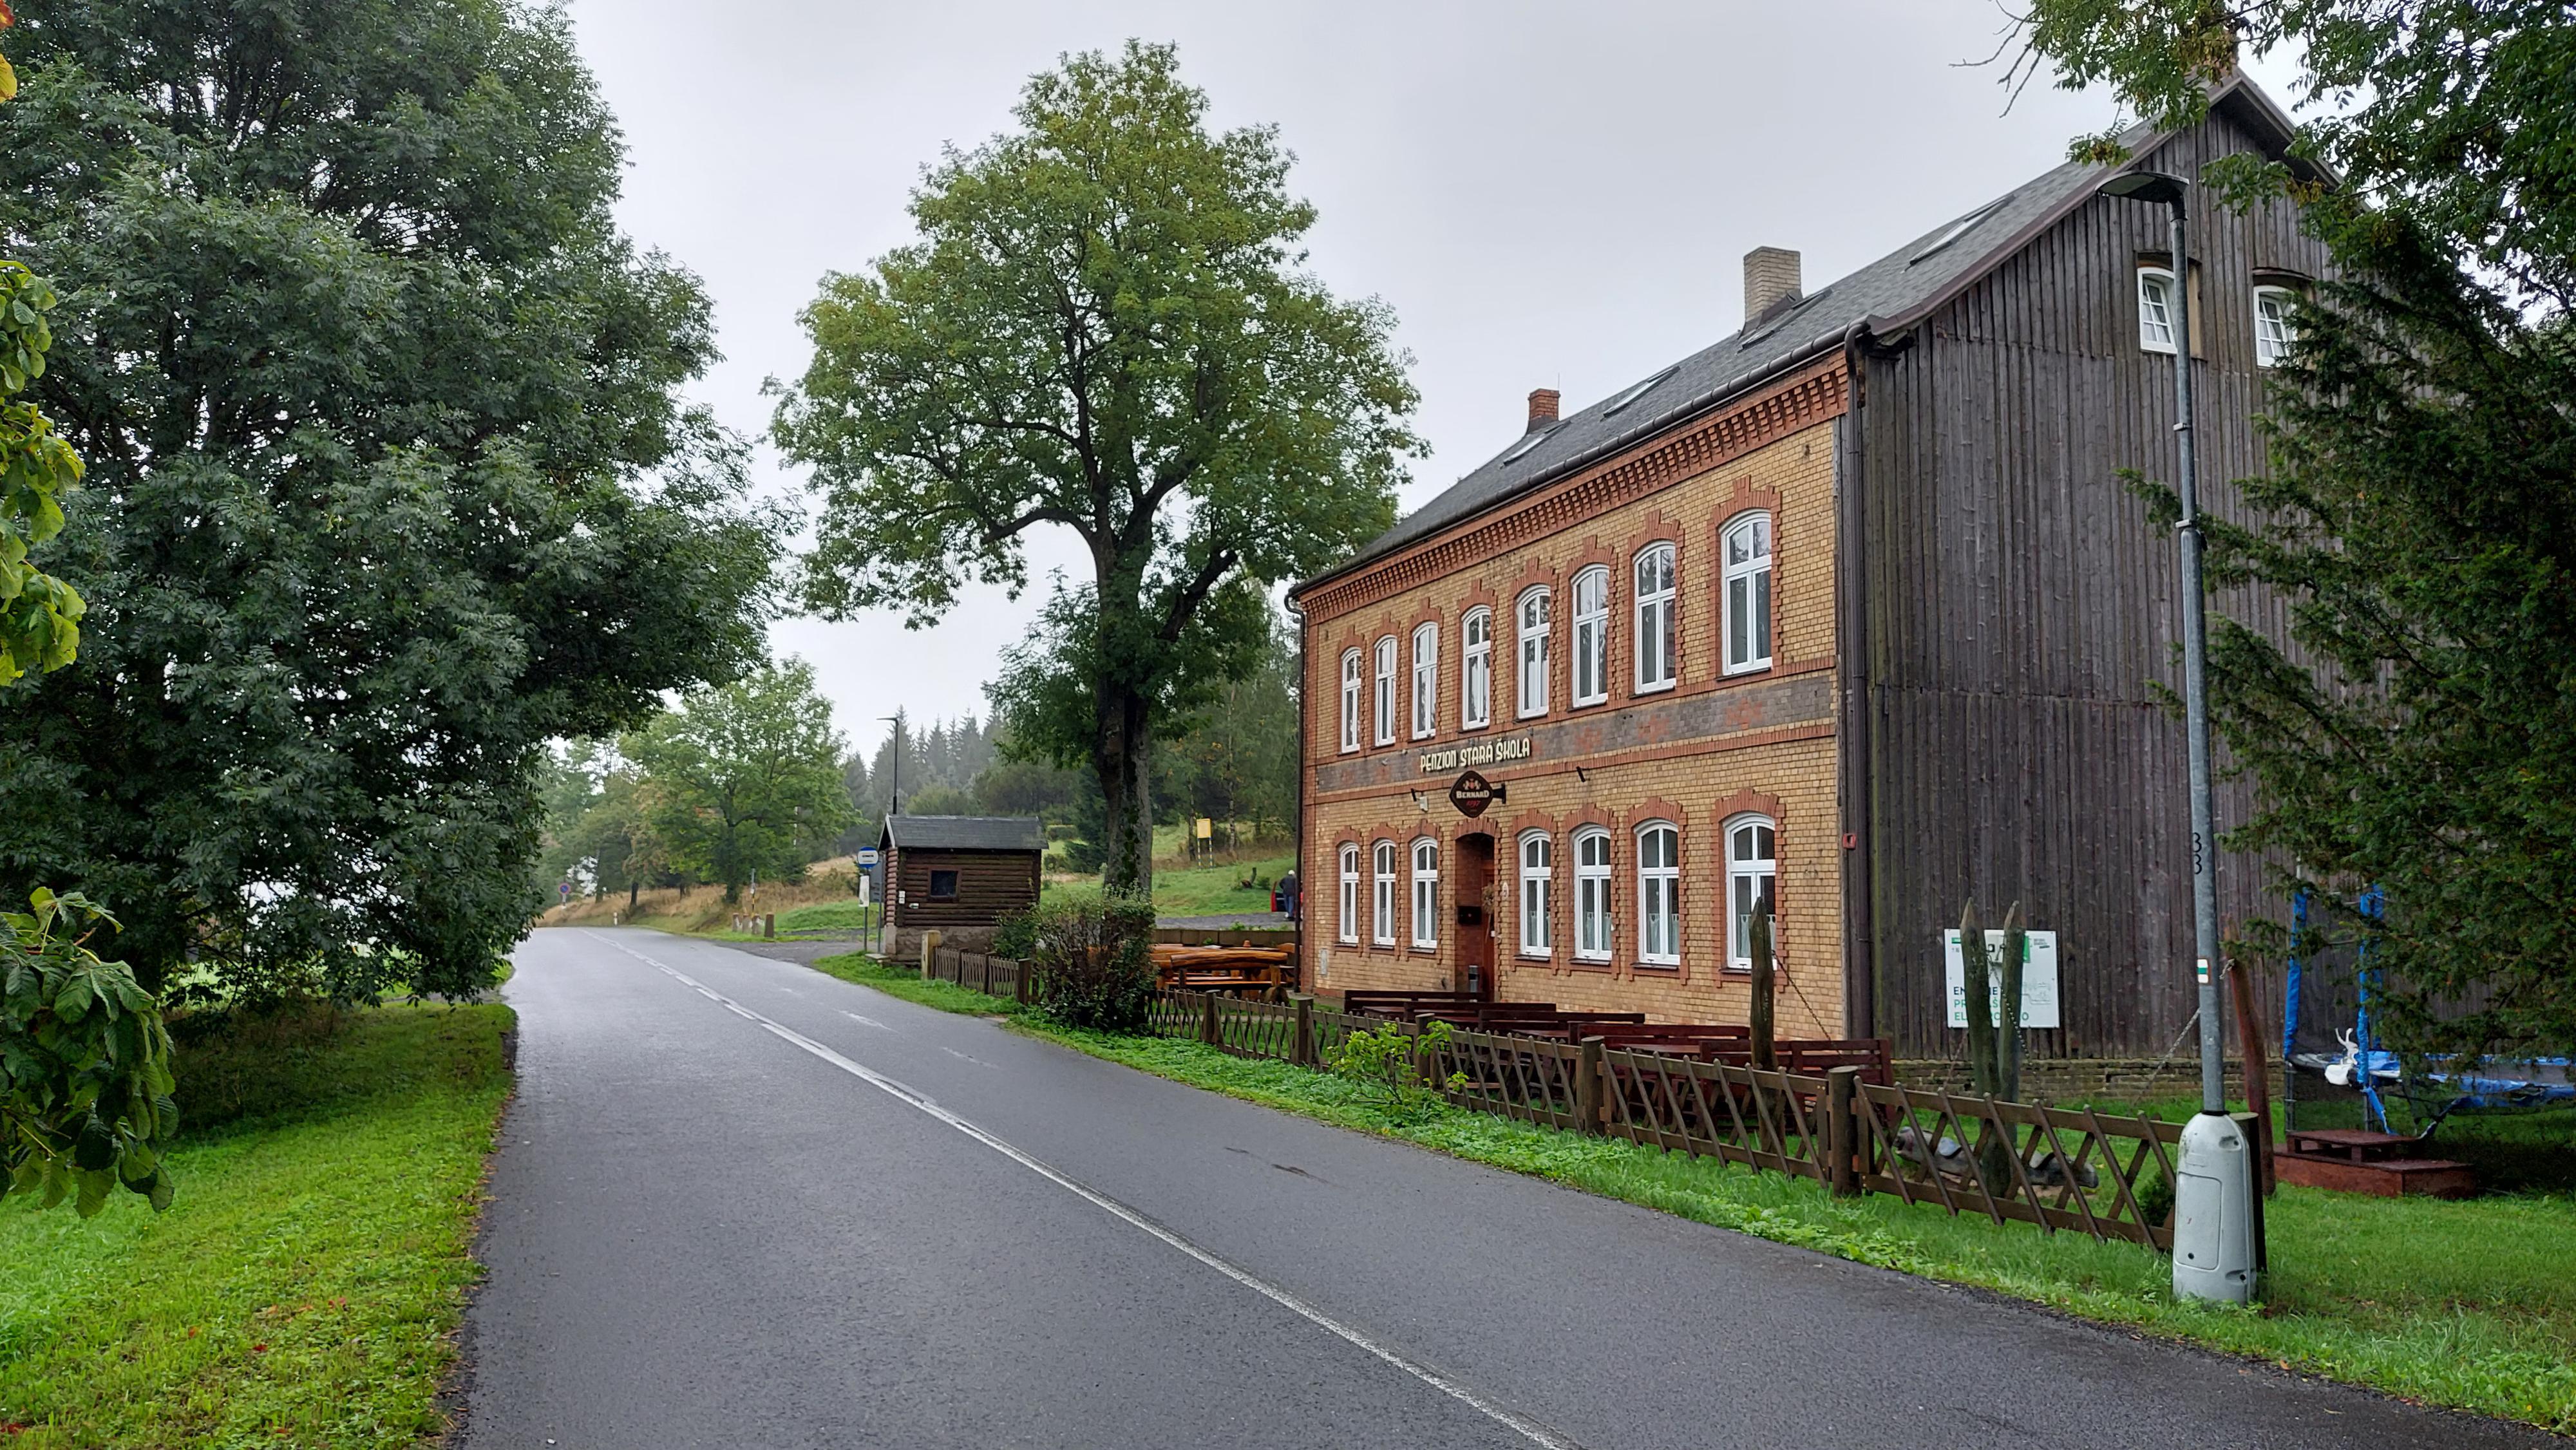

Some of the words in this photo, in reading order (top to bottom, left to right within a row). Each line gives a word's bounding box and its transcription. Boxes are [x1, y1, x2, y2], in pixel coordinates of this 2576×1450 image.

[1420, 749, 1457, 772] PENZION
[1460, 741, 1493, 766] STARÁ
[1496, 737, 1530, 760] ŠKOLA
[1456, 790, 1490, 798] BERNARD
